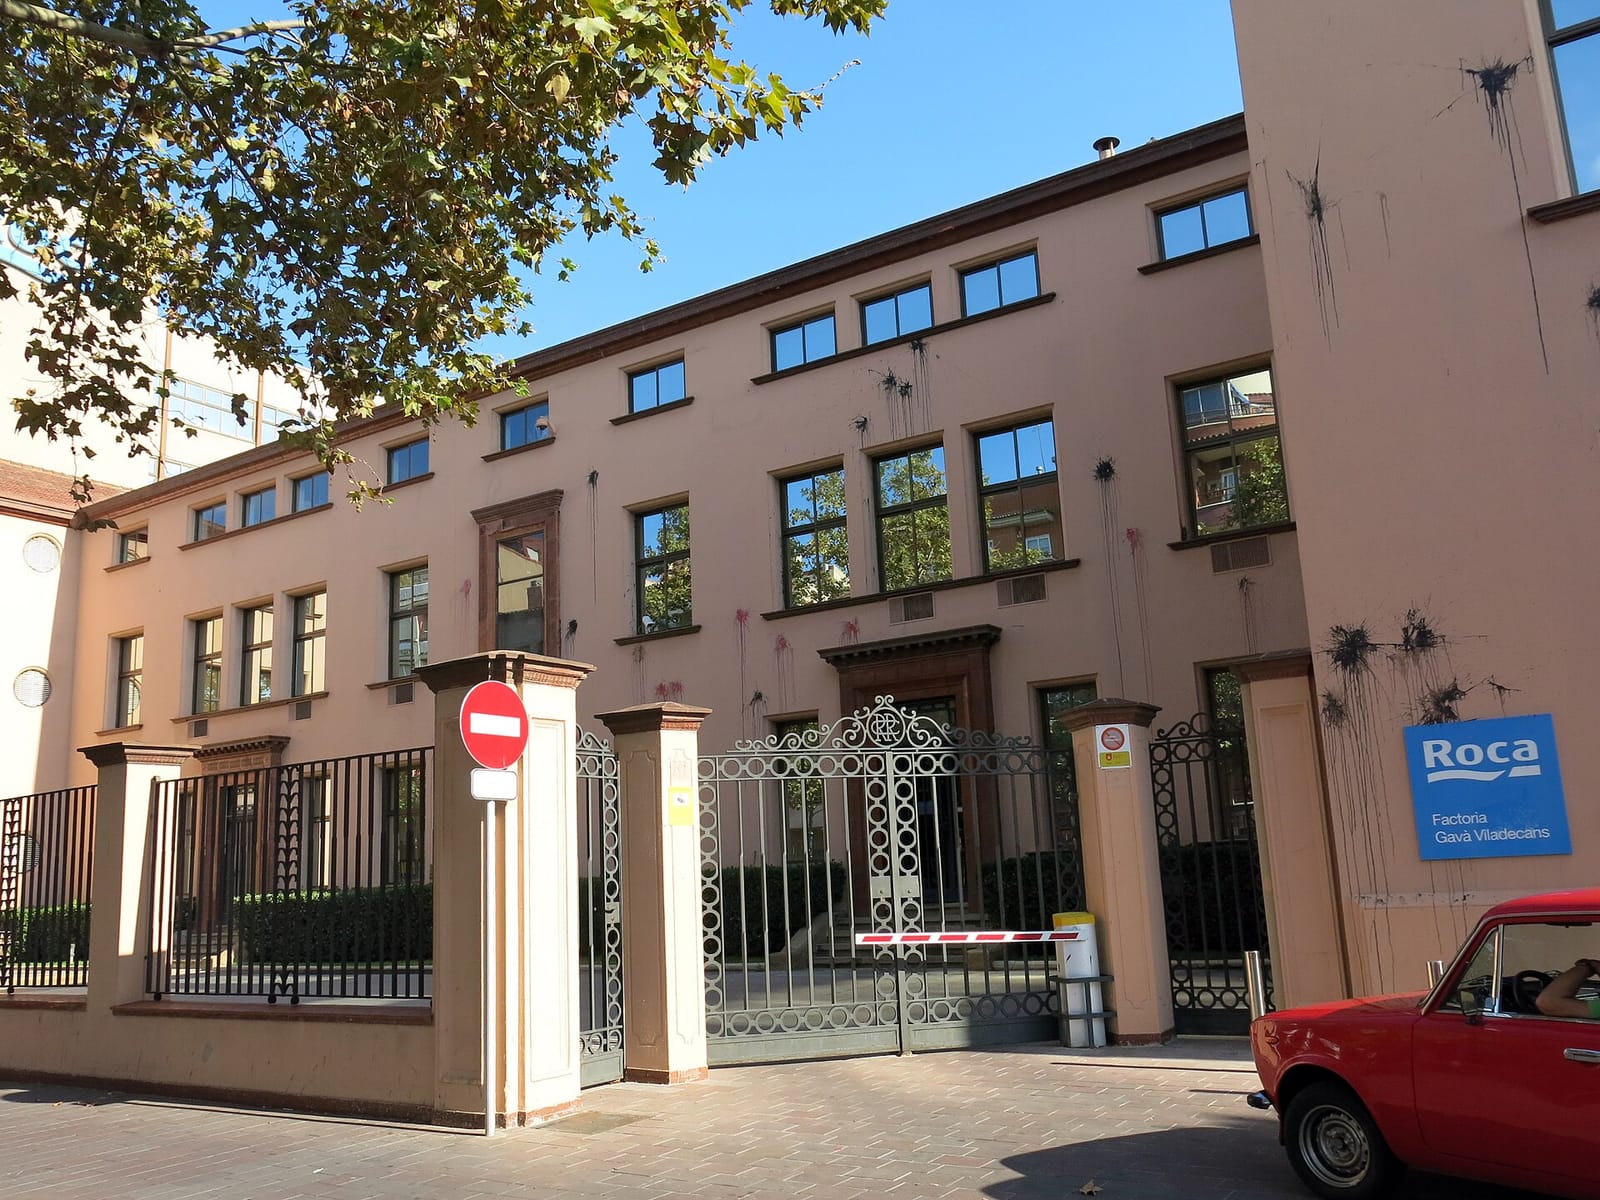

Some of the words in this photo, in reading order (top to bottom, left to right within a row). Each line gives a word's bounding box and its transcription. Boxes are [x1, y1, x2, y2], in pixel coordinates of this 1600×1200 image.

[1422, 739, 1539, 768] Roca
[1432, 811, 1488, 826] Factoria
[1435, 830, 1472, 844] Gavà
[1474, 827, 1550, 841] Viladecans
